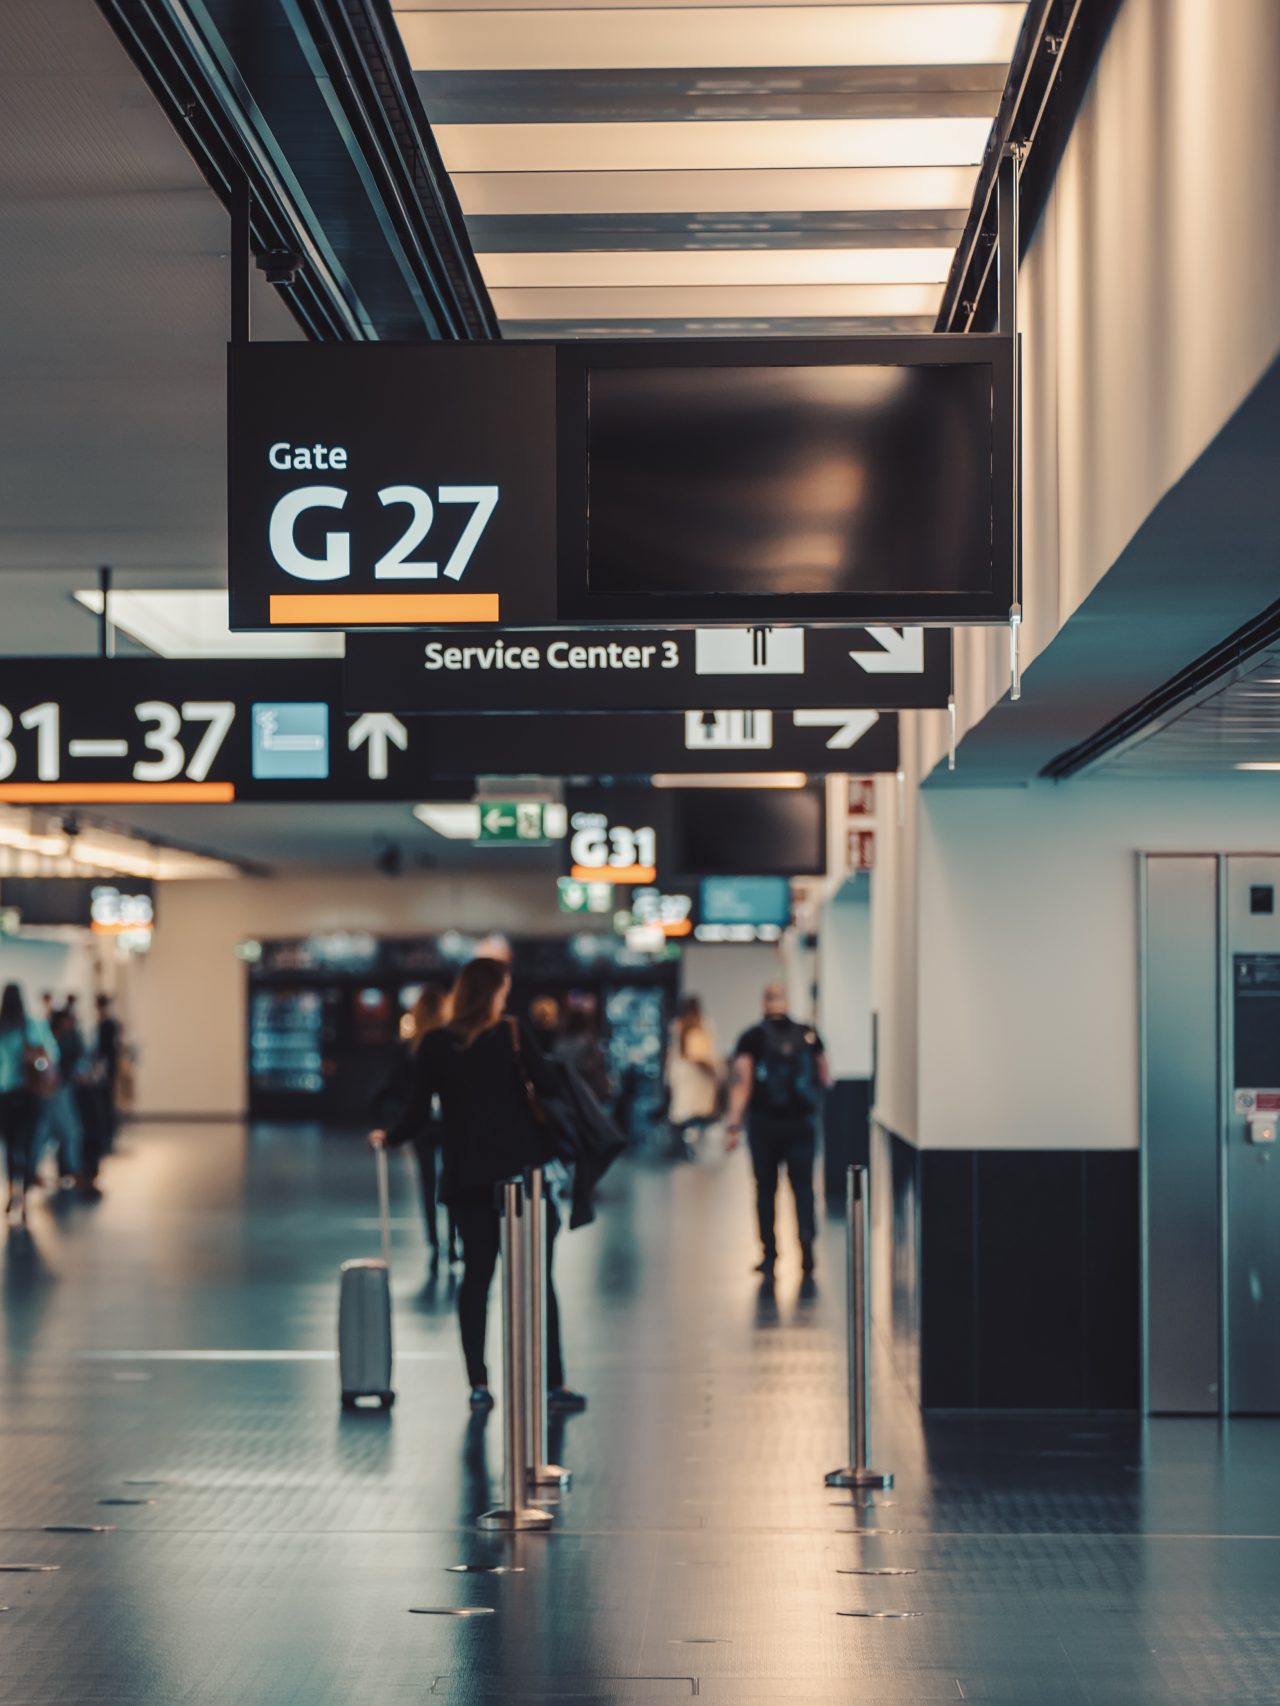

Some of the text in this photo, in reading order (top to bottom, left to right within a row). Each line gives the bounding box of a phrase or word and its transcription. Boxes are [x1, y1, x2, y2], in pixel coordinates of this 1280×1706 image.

[269, 442, 348, 470] Gate
[269, 485, 499, 581] G 27
[424, 639, 679, 670] Service Center 3
